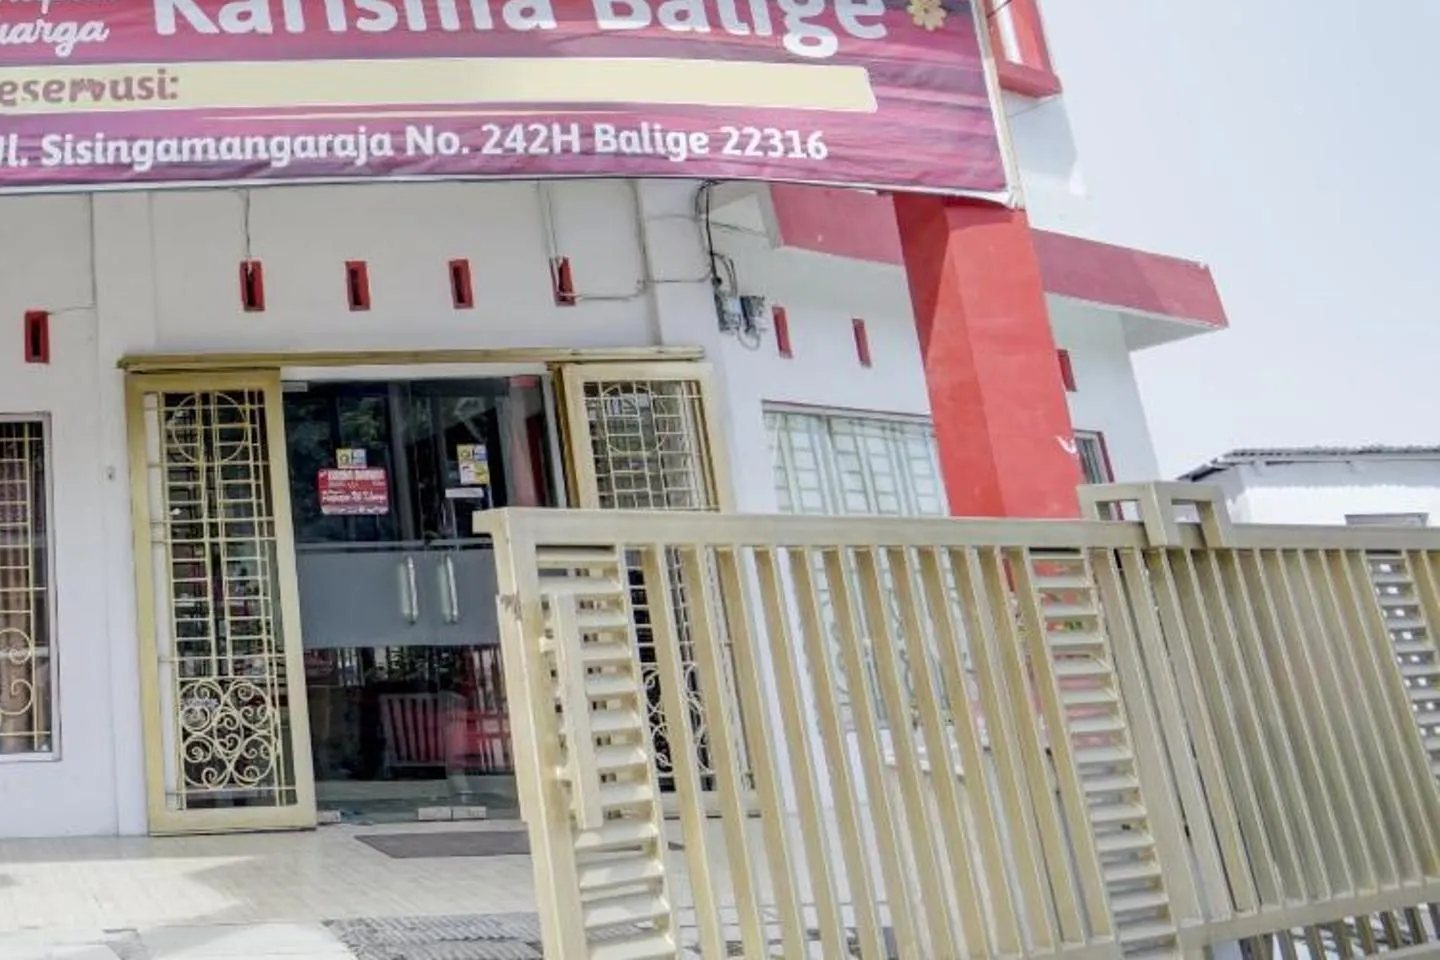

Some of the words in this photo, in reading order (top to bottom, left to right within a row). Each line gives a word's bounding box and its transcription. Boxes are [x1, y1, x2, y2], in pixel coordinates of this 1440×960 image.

[41, 126, 393, 172] Sisingamangaraja
[405, 123, 469, 157] No.
[481, 123, 581, 156] 242H
[594, 124, 709, 161] Balige
[721, 126, 828, 160] 22316
